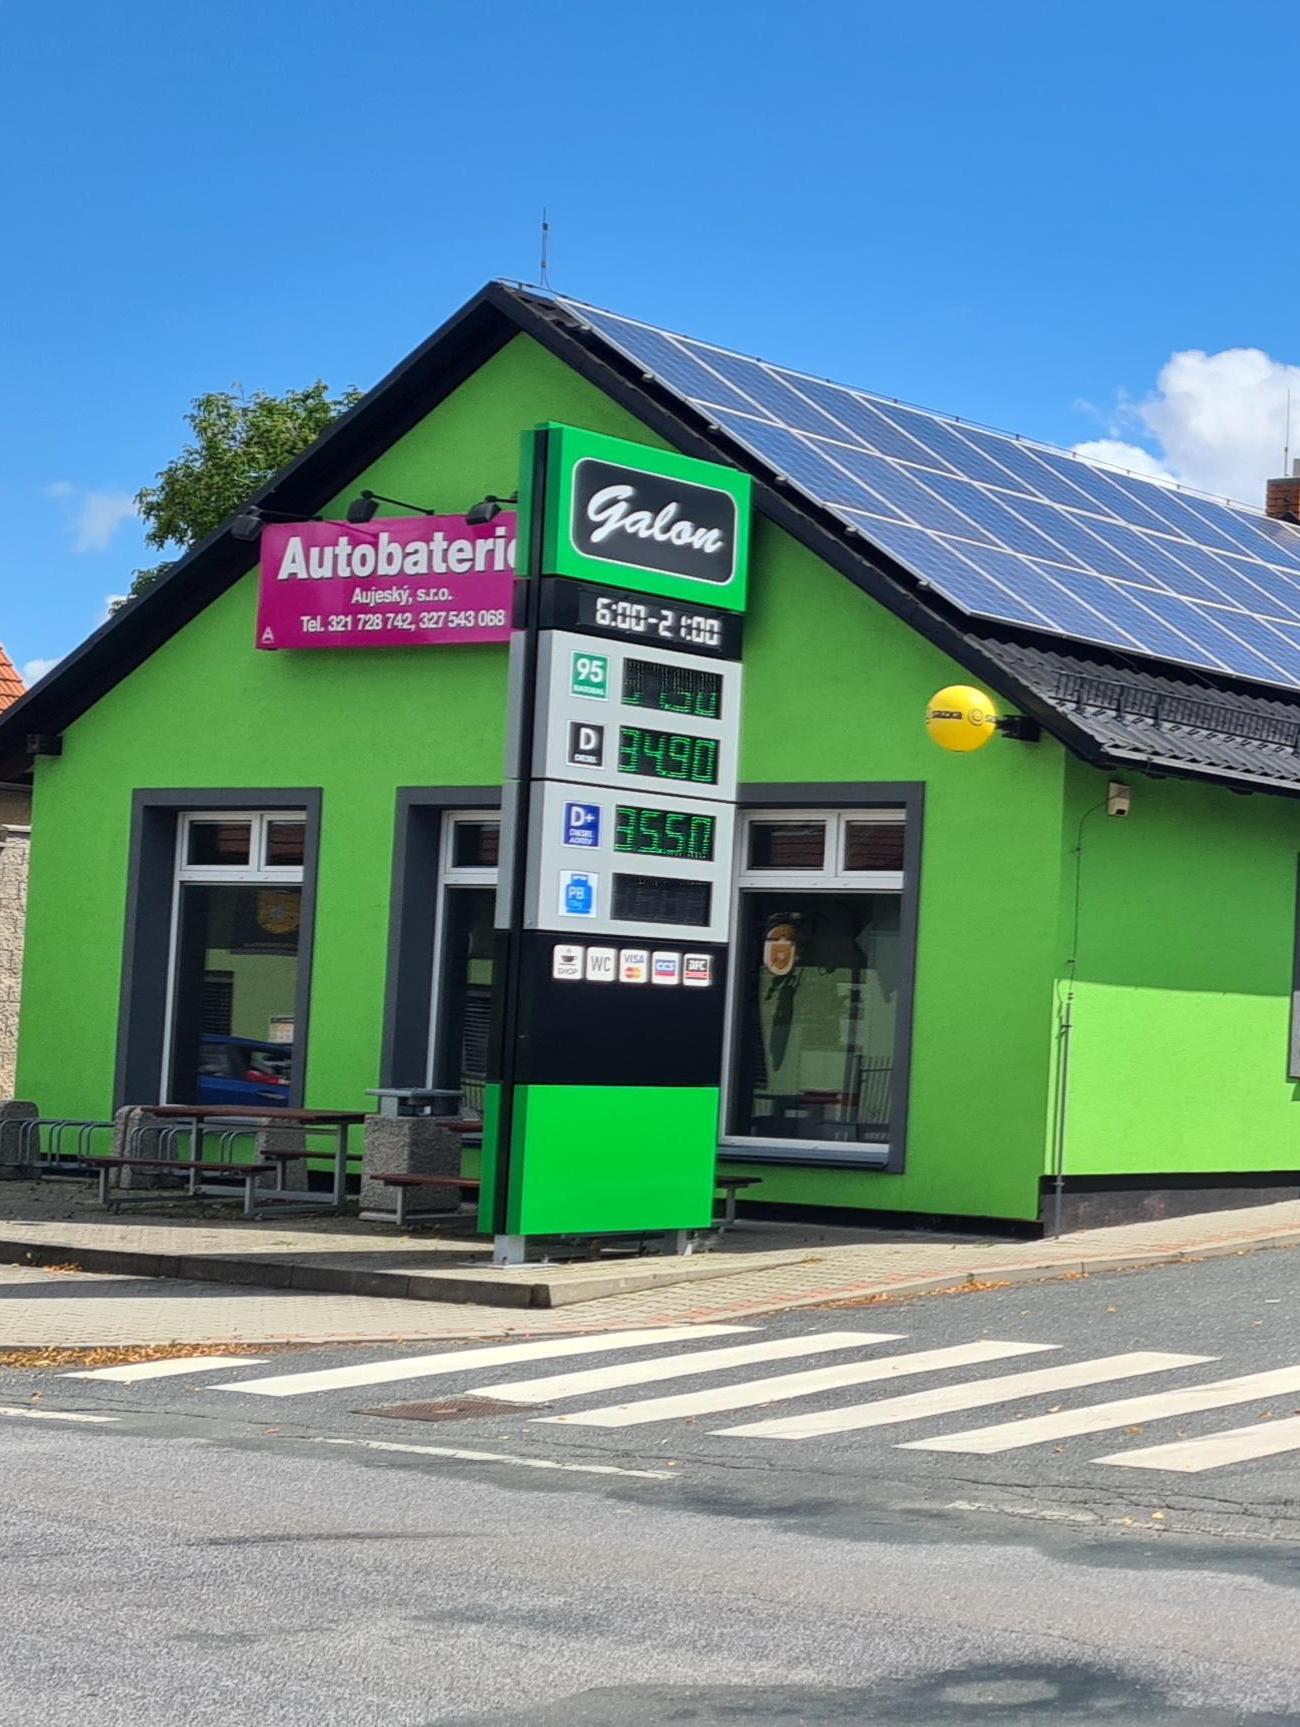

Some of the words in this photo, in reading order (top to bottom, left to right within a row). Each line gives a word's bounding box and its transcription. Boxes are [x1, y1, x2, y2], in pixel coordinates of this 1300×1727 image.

[587, 485, 724, 553] Galon
[351, 585, 412, 607] Aujeský,
[416, 587, 453, 602] s.r.o.
[300, 615, 323, 633] Tel.
[327, 614, 353, 632] 321
[357, 613, 383, 631] 728
[386, 612, 415, 632] 742,
[419, 611, 445, 630] 327
[448, 610, 475, 628] 543
[478, 609, 505, 627] 068
[576, 657, 604, 683] 95
[579, 727, 597, 750] D
[571, 806, 595, 827] D+
[569, 886, 585, 900] PB
[590, 955, 611, 973] WC
[624, 953, 645, 964] VISA
